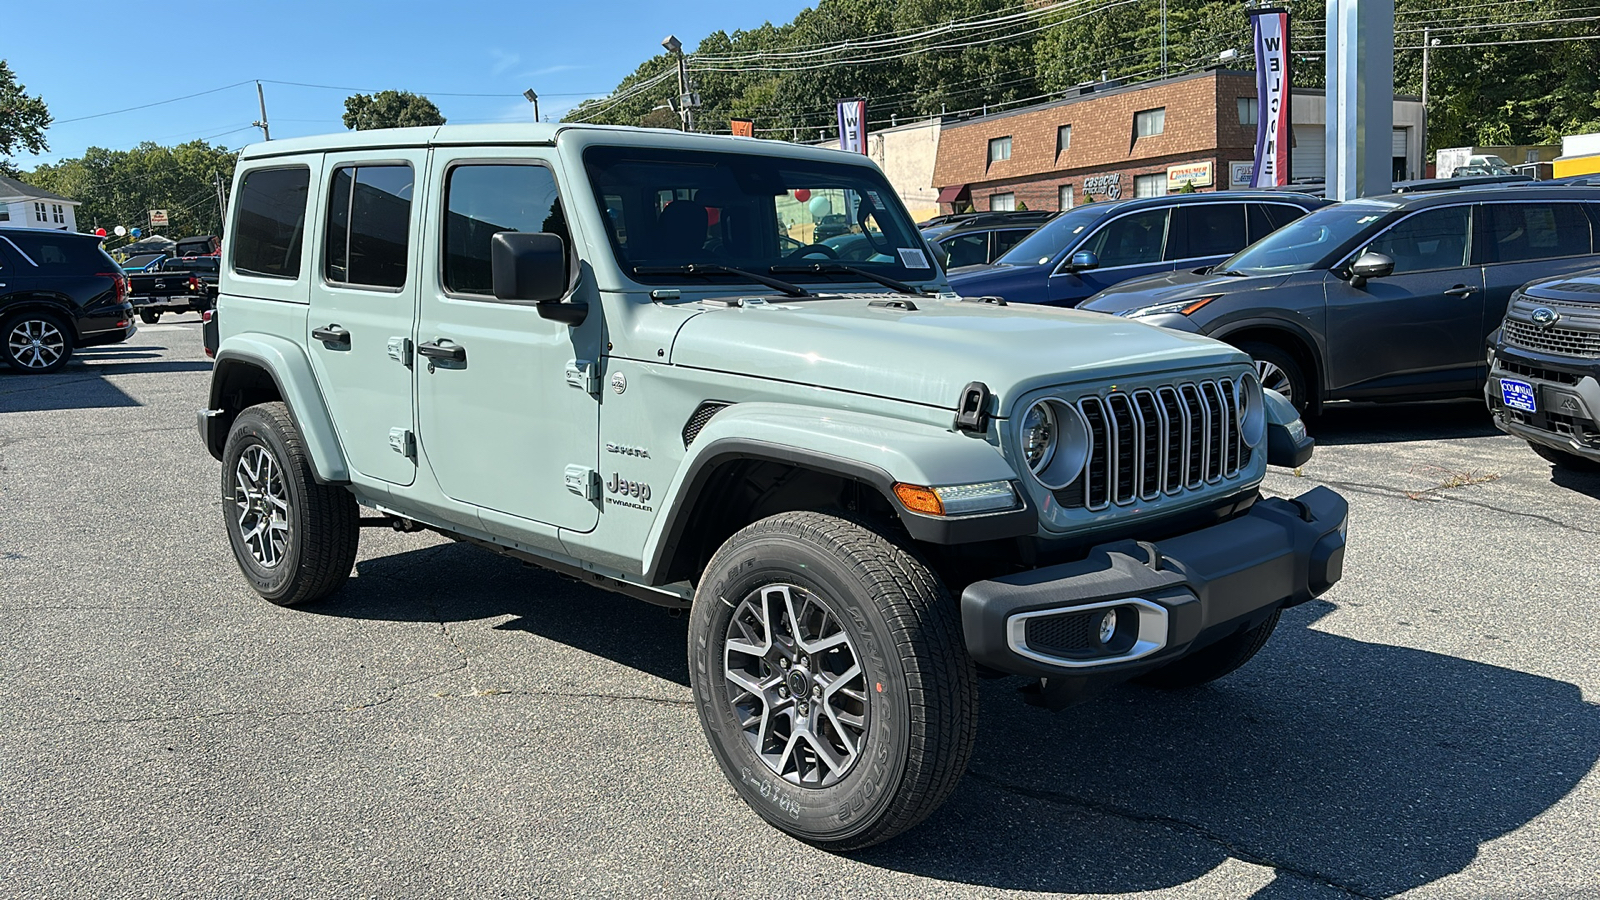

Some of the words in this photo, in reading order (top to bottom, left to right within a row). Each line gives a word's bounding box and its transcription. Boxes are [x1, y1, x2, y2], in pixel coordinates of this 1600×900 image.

[1169, 166, 1208, 181] CONSUMER
[1502, 383, 1533, 397] COLONIAL
[606, 443, 651, 459] SAHARA
[606, 471, 652, 504] Jeep
[612, 498, 653, 512] WRANGLER
[838, 605, 893, 822] BRIDGESTONE
